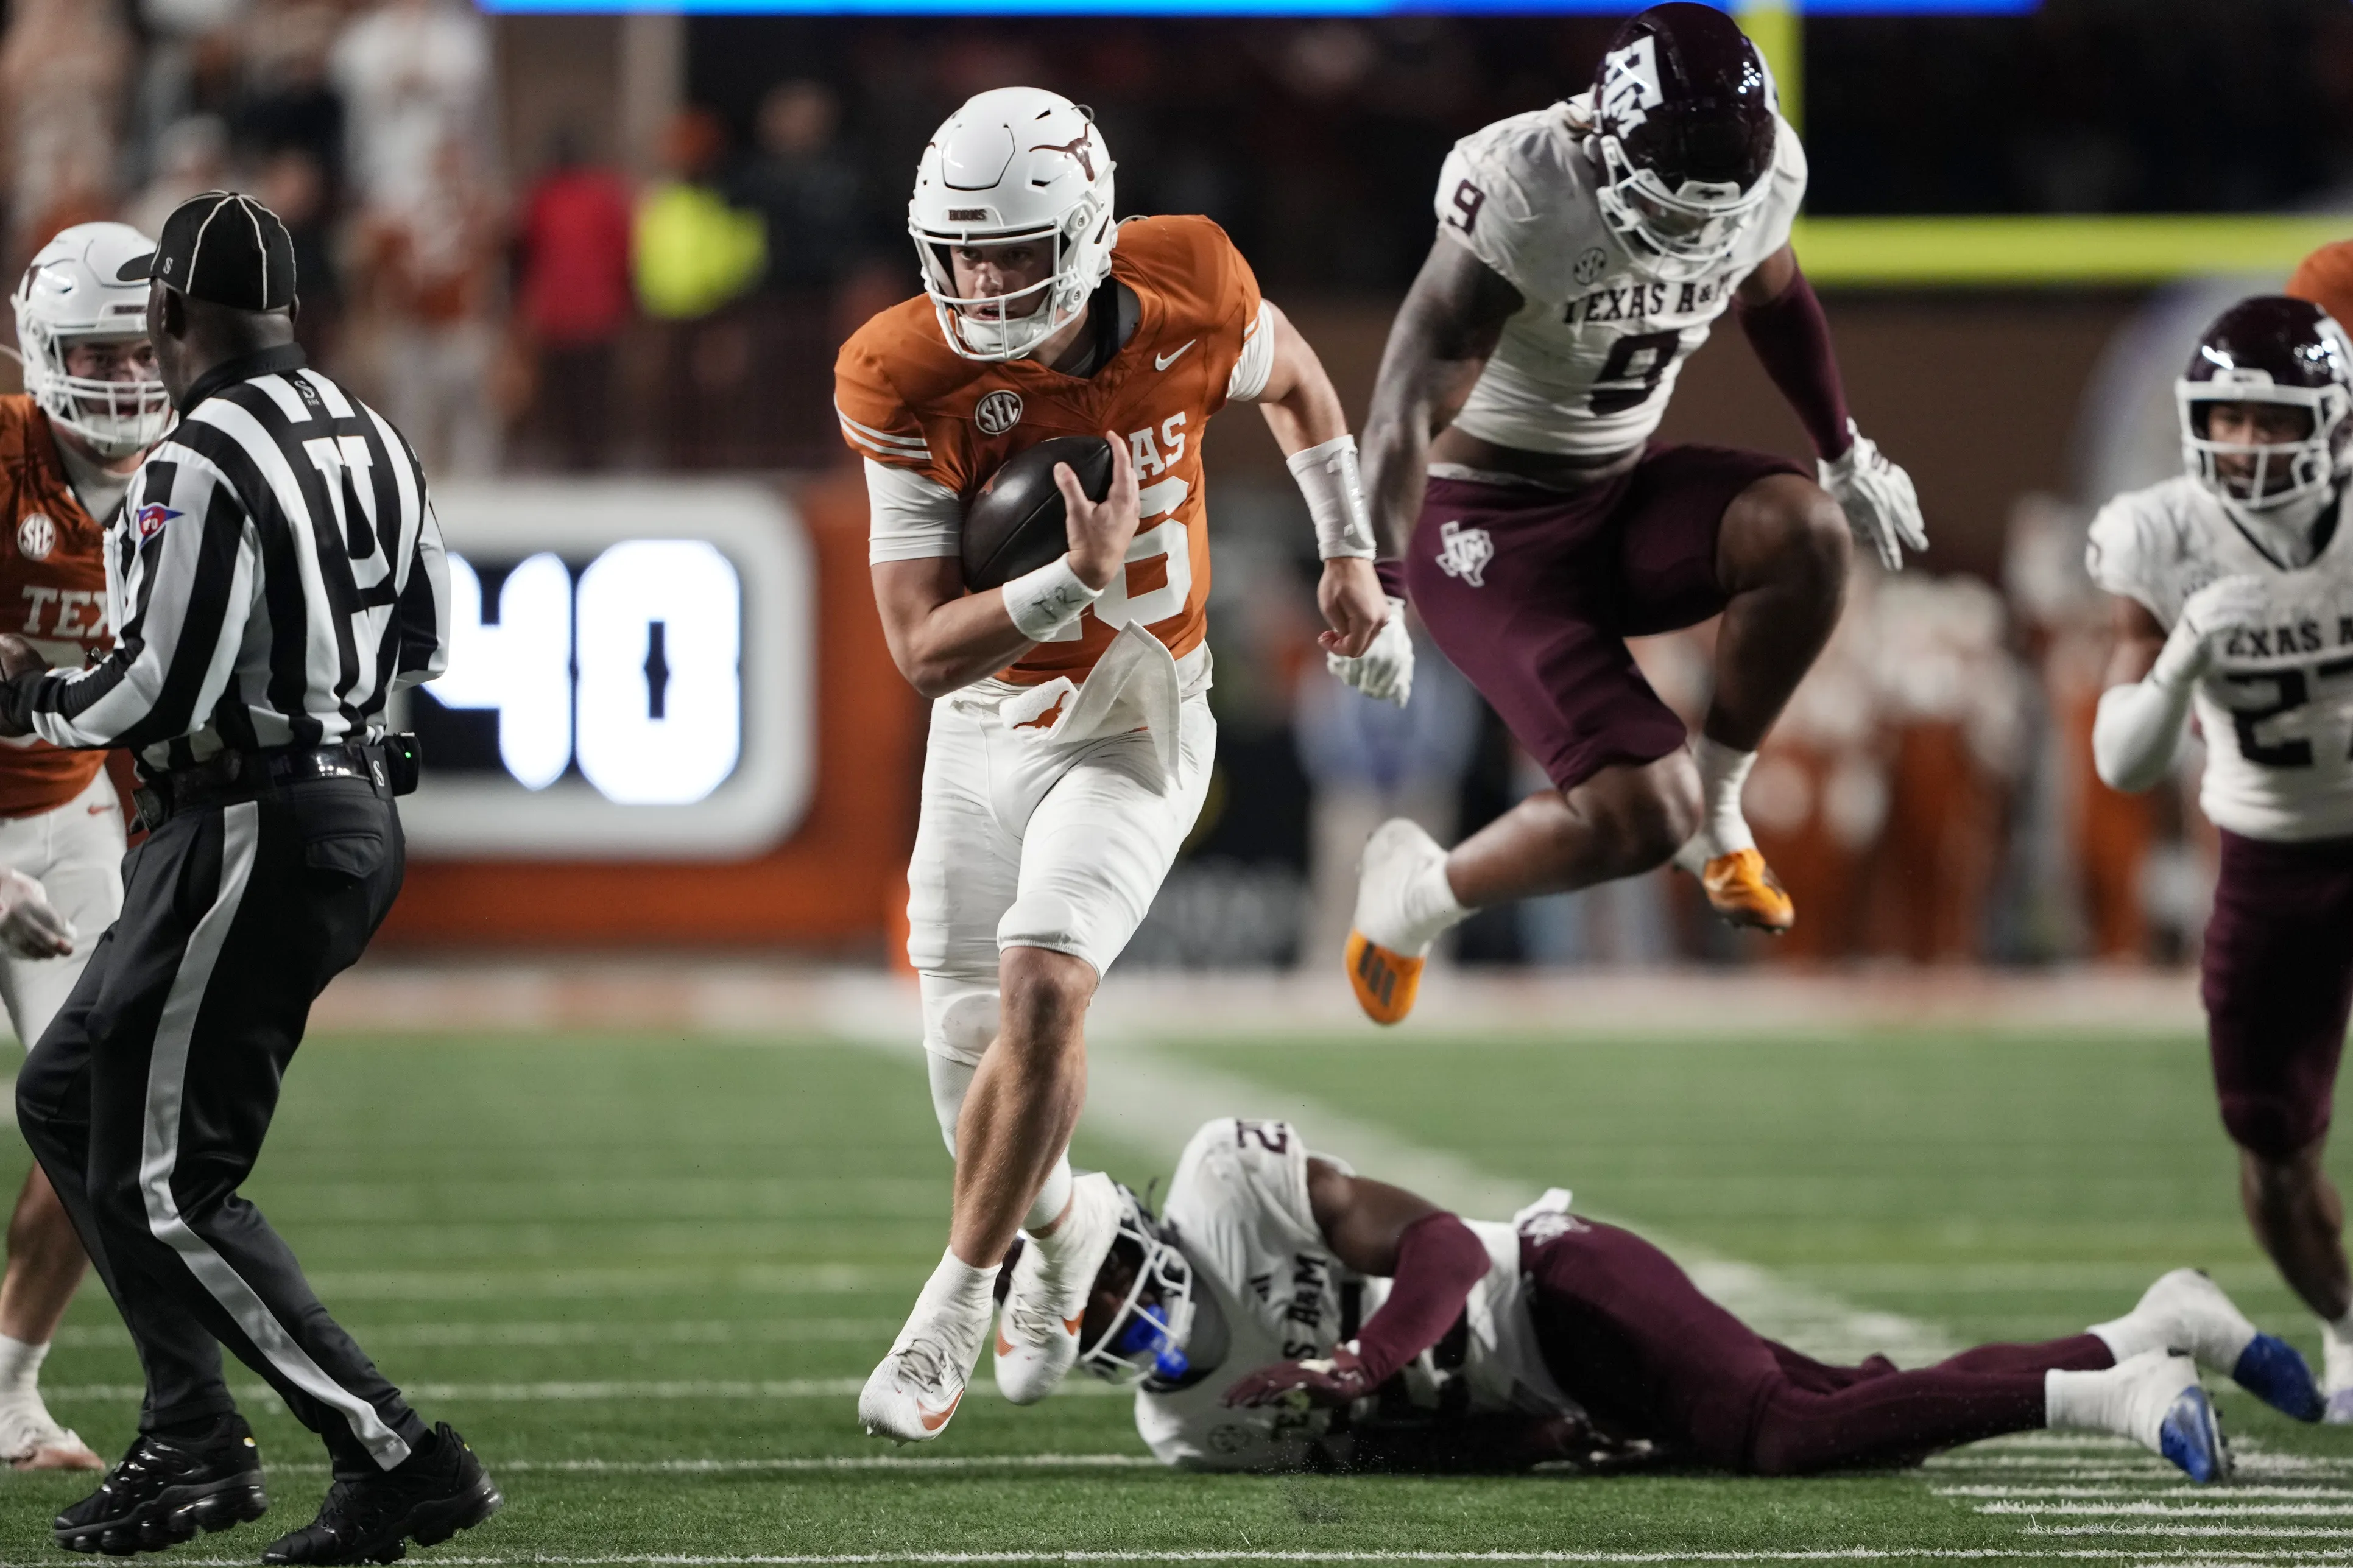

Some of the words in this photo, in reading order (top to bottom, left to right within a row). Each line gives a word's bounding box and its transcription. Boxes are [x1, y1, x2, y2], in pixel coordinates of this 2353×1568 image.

[1447, 179, 1486, 236] 9
[1562, 281, 1667, 324] TEXAS
[979, 393, 1019, 431] SEC
[21, 515, 55, 555] SEC
[420, 539, 740, 806] 40
